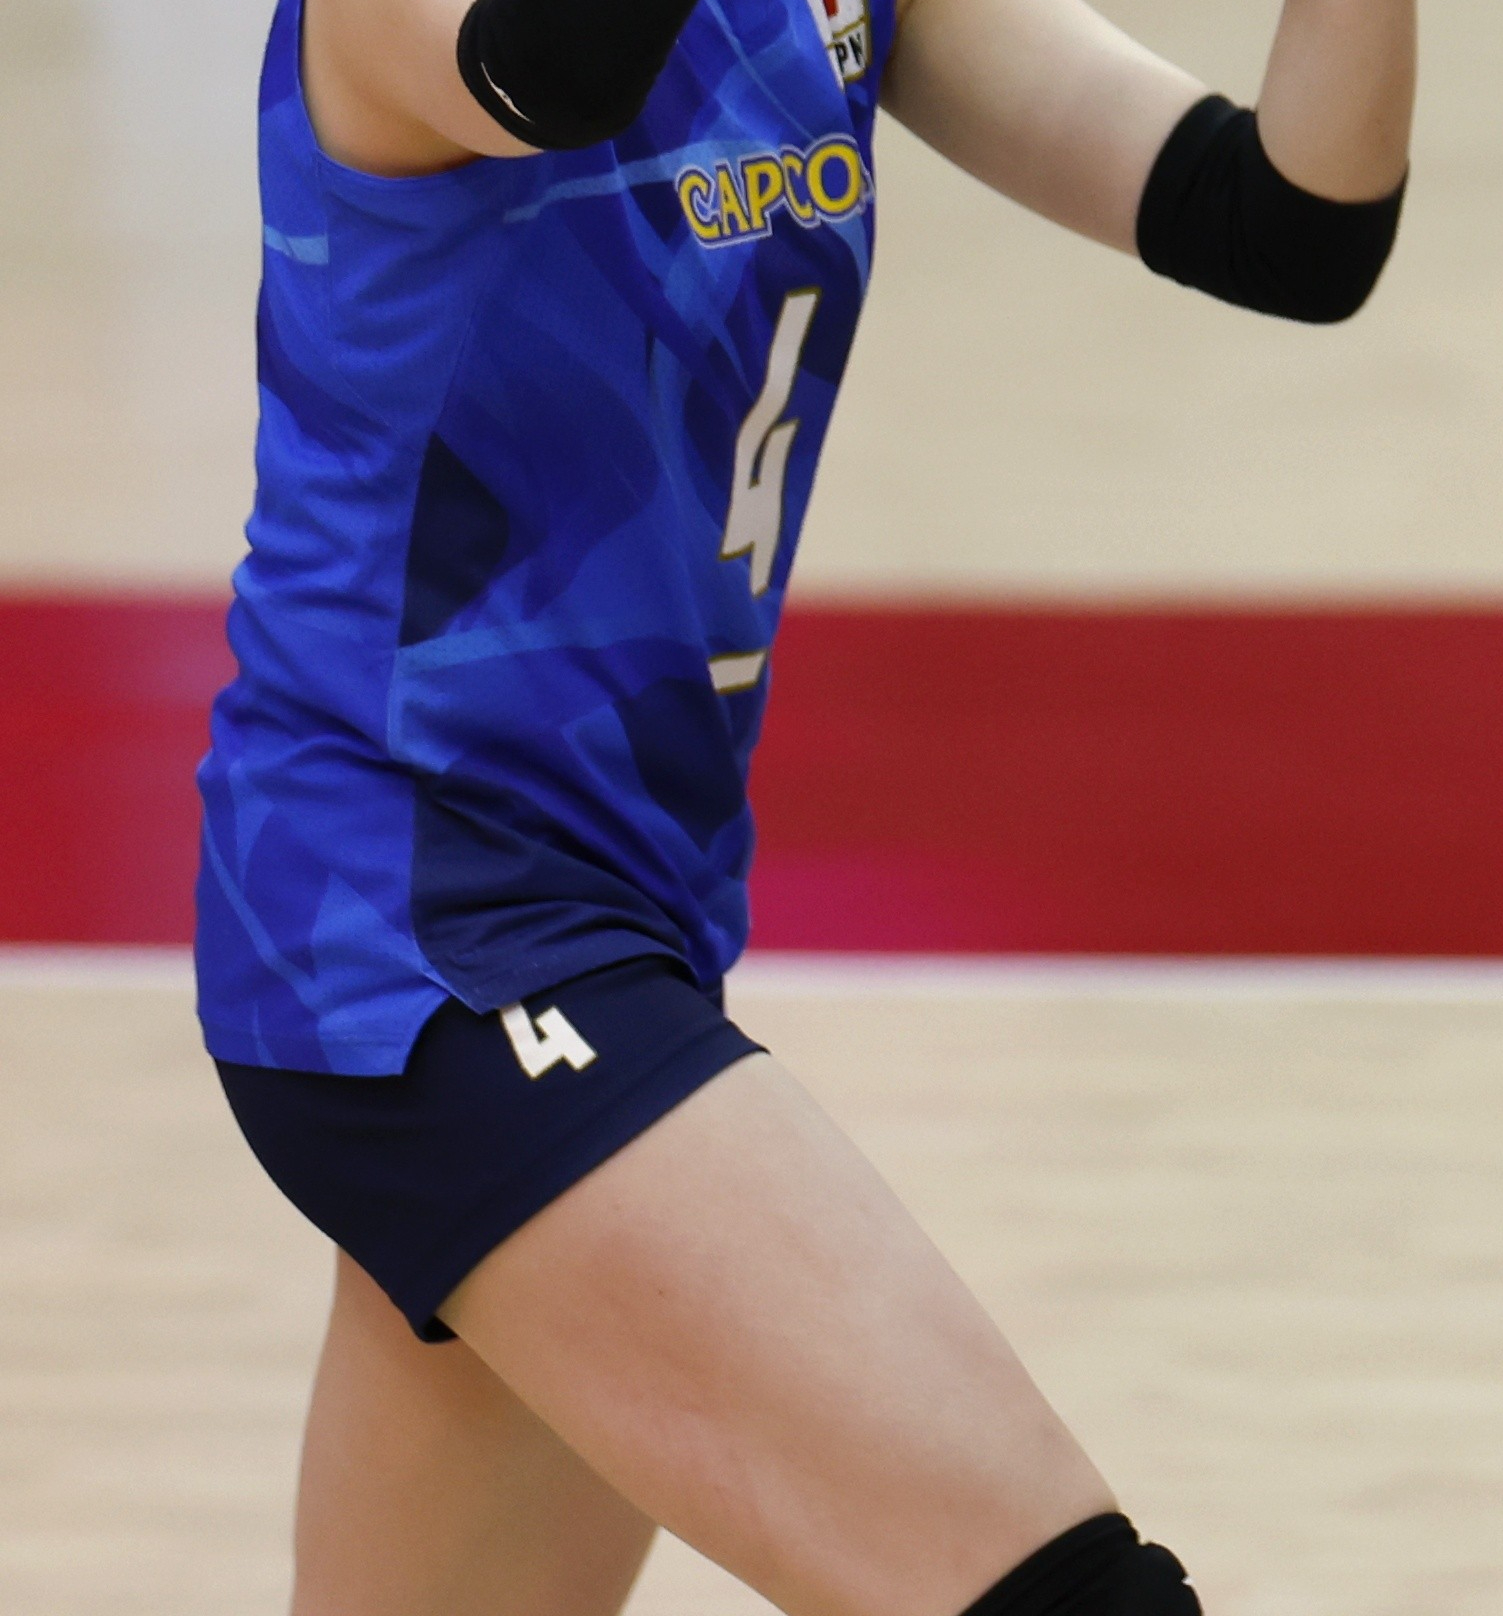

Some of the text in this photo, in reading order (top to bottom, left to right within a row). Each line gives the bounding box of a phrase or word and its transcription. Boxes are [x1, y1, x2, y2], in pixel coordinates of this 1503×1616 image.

[834, 32, 864, 75] PN
[676, 134, 876, 249] CAPCO
[718, 286, 824, 599] 4
[499, 1002, 597, 1081] 4
